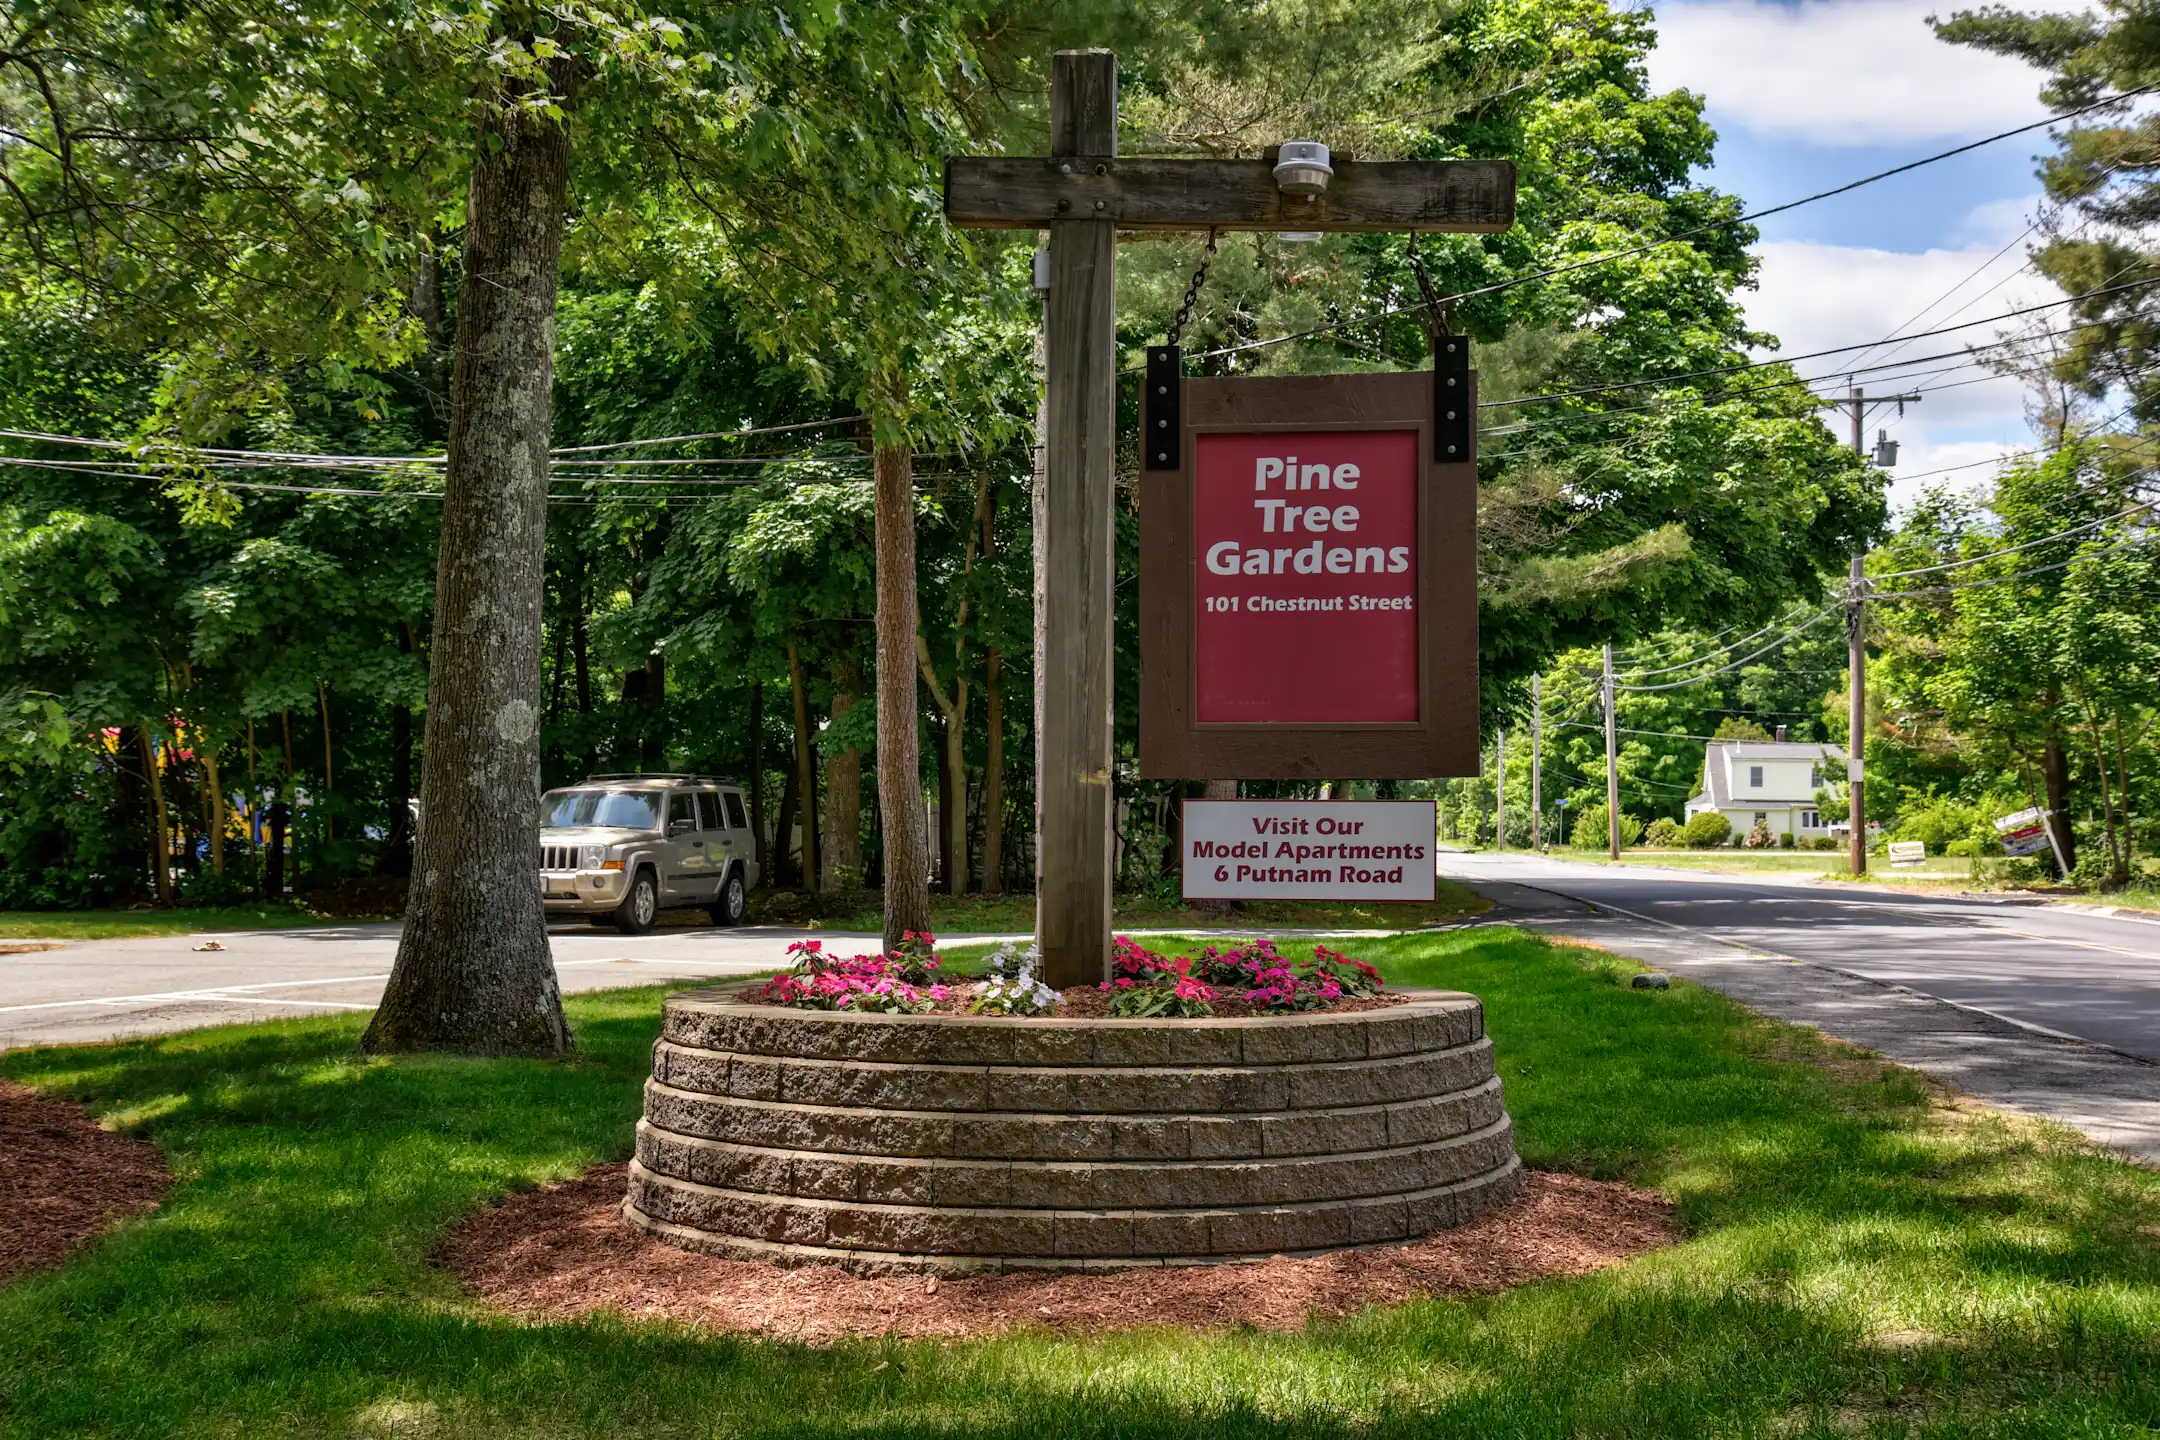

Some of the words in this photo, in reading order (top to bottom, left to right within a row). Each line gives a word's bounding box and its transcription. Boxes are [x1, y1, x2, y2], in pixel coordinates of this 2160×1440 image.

[1255, 457, 1361, 490] Pine
[1254, 499, 1360, 533] Tree
[1206, 541, 1409, 575] Gardens
[1205, 596, 1239, 613] 101
[1246, 595, 1344, 612] Chestnut
[1348, 594, 1413, 611] Street
[1252, 817, 1309, 835] Visit
[1316, 817, 1364, 835] Our
[1192, 841, 1269, 859] Model
[1274, 842, 1425, 864] Apartments
[1214, 865, 1230, 882] 6
[1236, 865, 1332, 883] Putnam
[1340, 864, 1403, 884] Road
